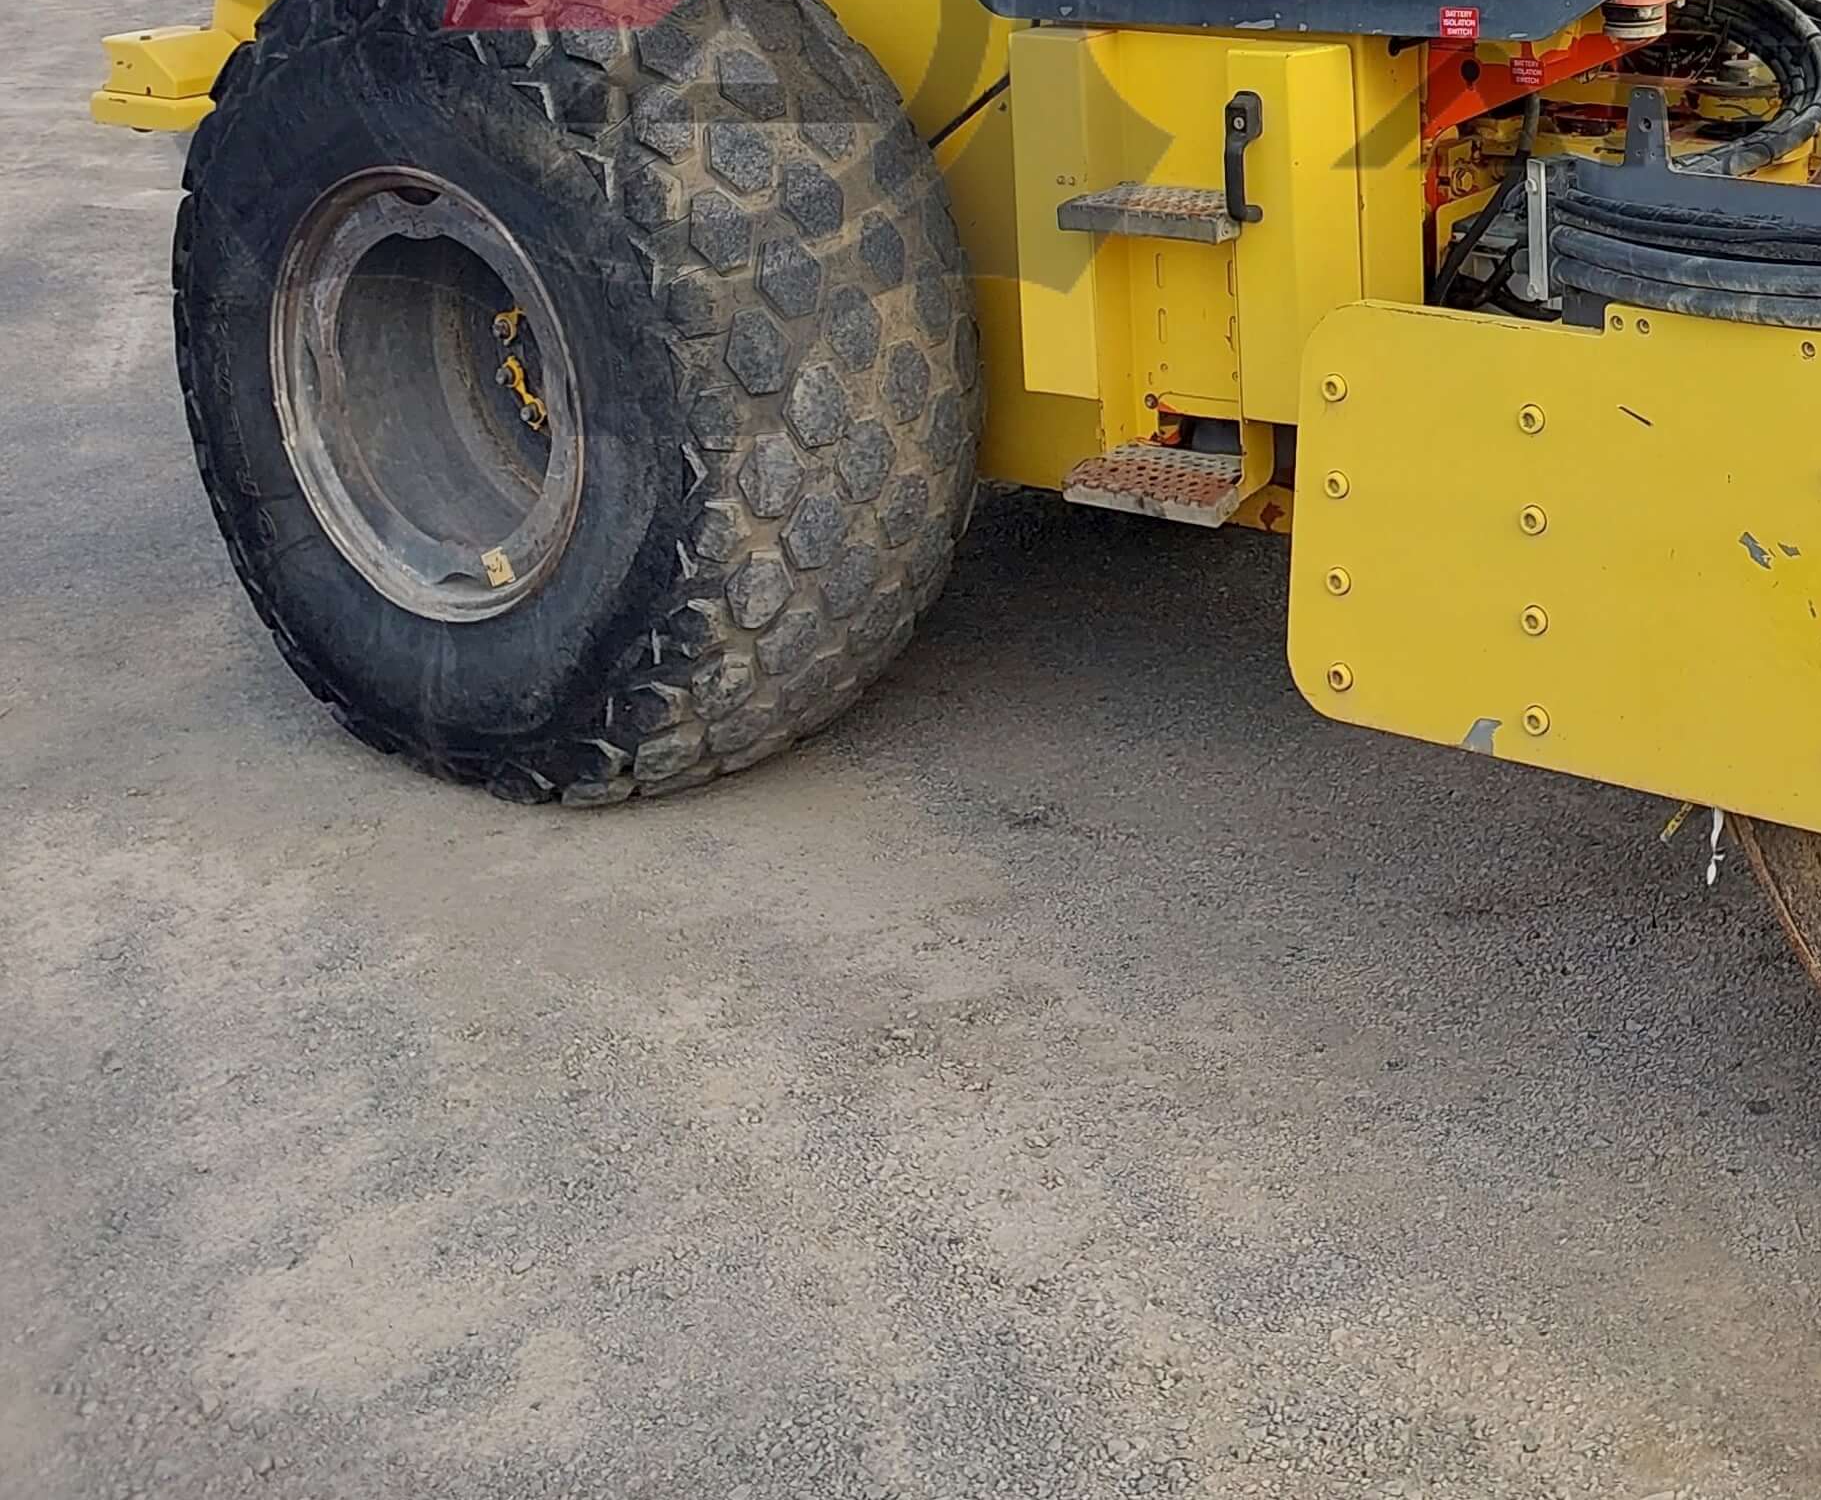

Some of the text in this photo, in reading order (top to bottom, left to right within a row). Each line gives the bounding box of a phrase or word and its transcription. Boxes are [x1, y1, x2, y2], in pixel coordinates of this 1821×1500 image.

[1445, 10, 1473, 18] BATTERY
[1443, 19, 1476, 27] ISOLATION
[1447, 28, 1473, 36] SWITCH
[1514, 59, 1539, 67] BATTERY
[1512, 68, 1542, 76] ISOLATION
[1516, 76, 1540, 84] SWITCH
